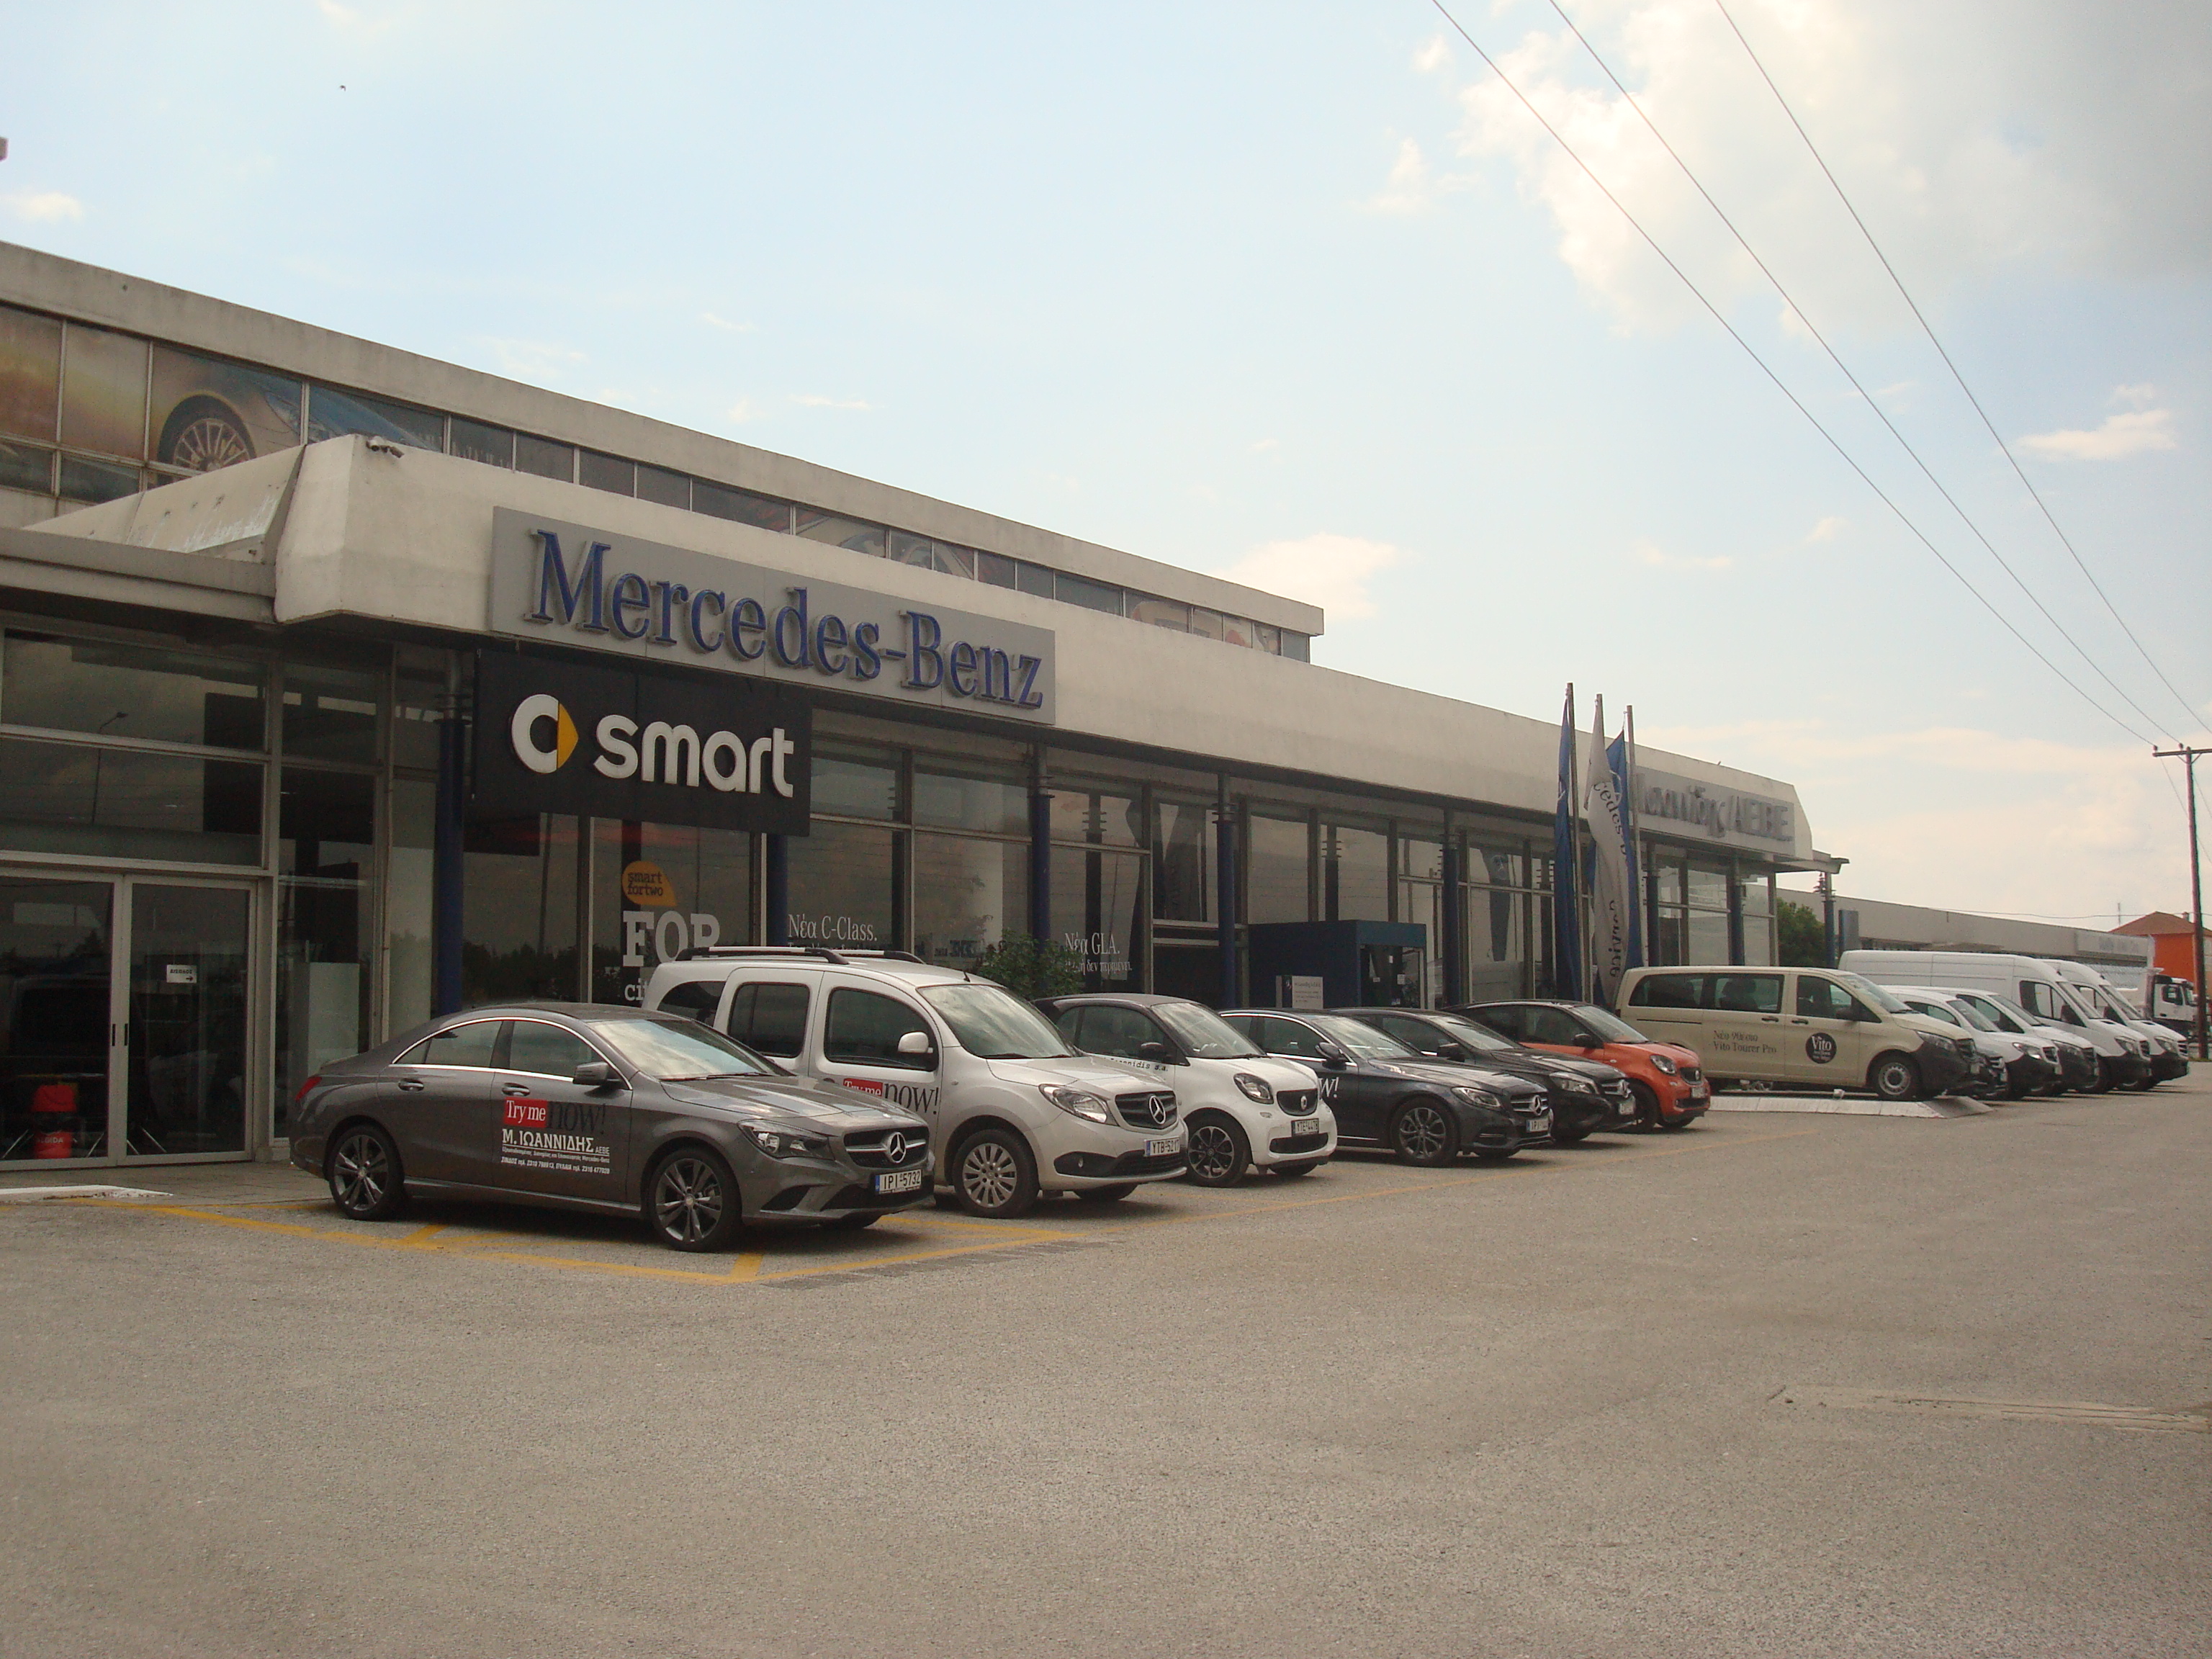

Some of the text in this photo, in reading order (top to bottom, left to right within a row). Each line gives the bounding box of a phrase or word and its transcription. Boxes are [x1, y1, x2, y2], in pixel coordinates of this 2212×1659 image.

[524, 530, 1043, 709] Mercedes-Benz
[594, 714, 793, 798] smart
[627, 871, 662, 884] smart
[627, 882, 664, 896] fortwo
[788, 913, 877, 941] Νέα C-Class.
[1092, 932, 1120, 955] GLA.
[1811, 1035, 1832, 1051] Vito
[506, 1100, 527, 1124] Try
[527, 1105, 547, 1122] me
[519, 1130, 594, 1153] ΙΩΑΝΝΙΔΗΣ
